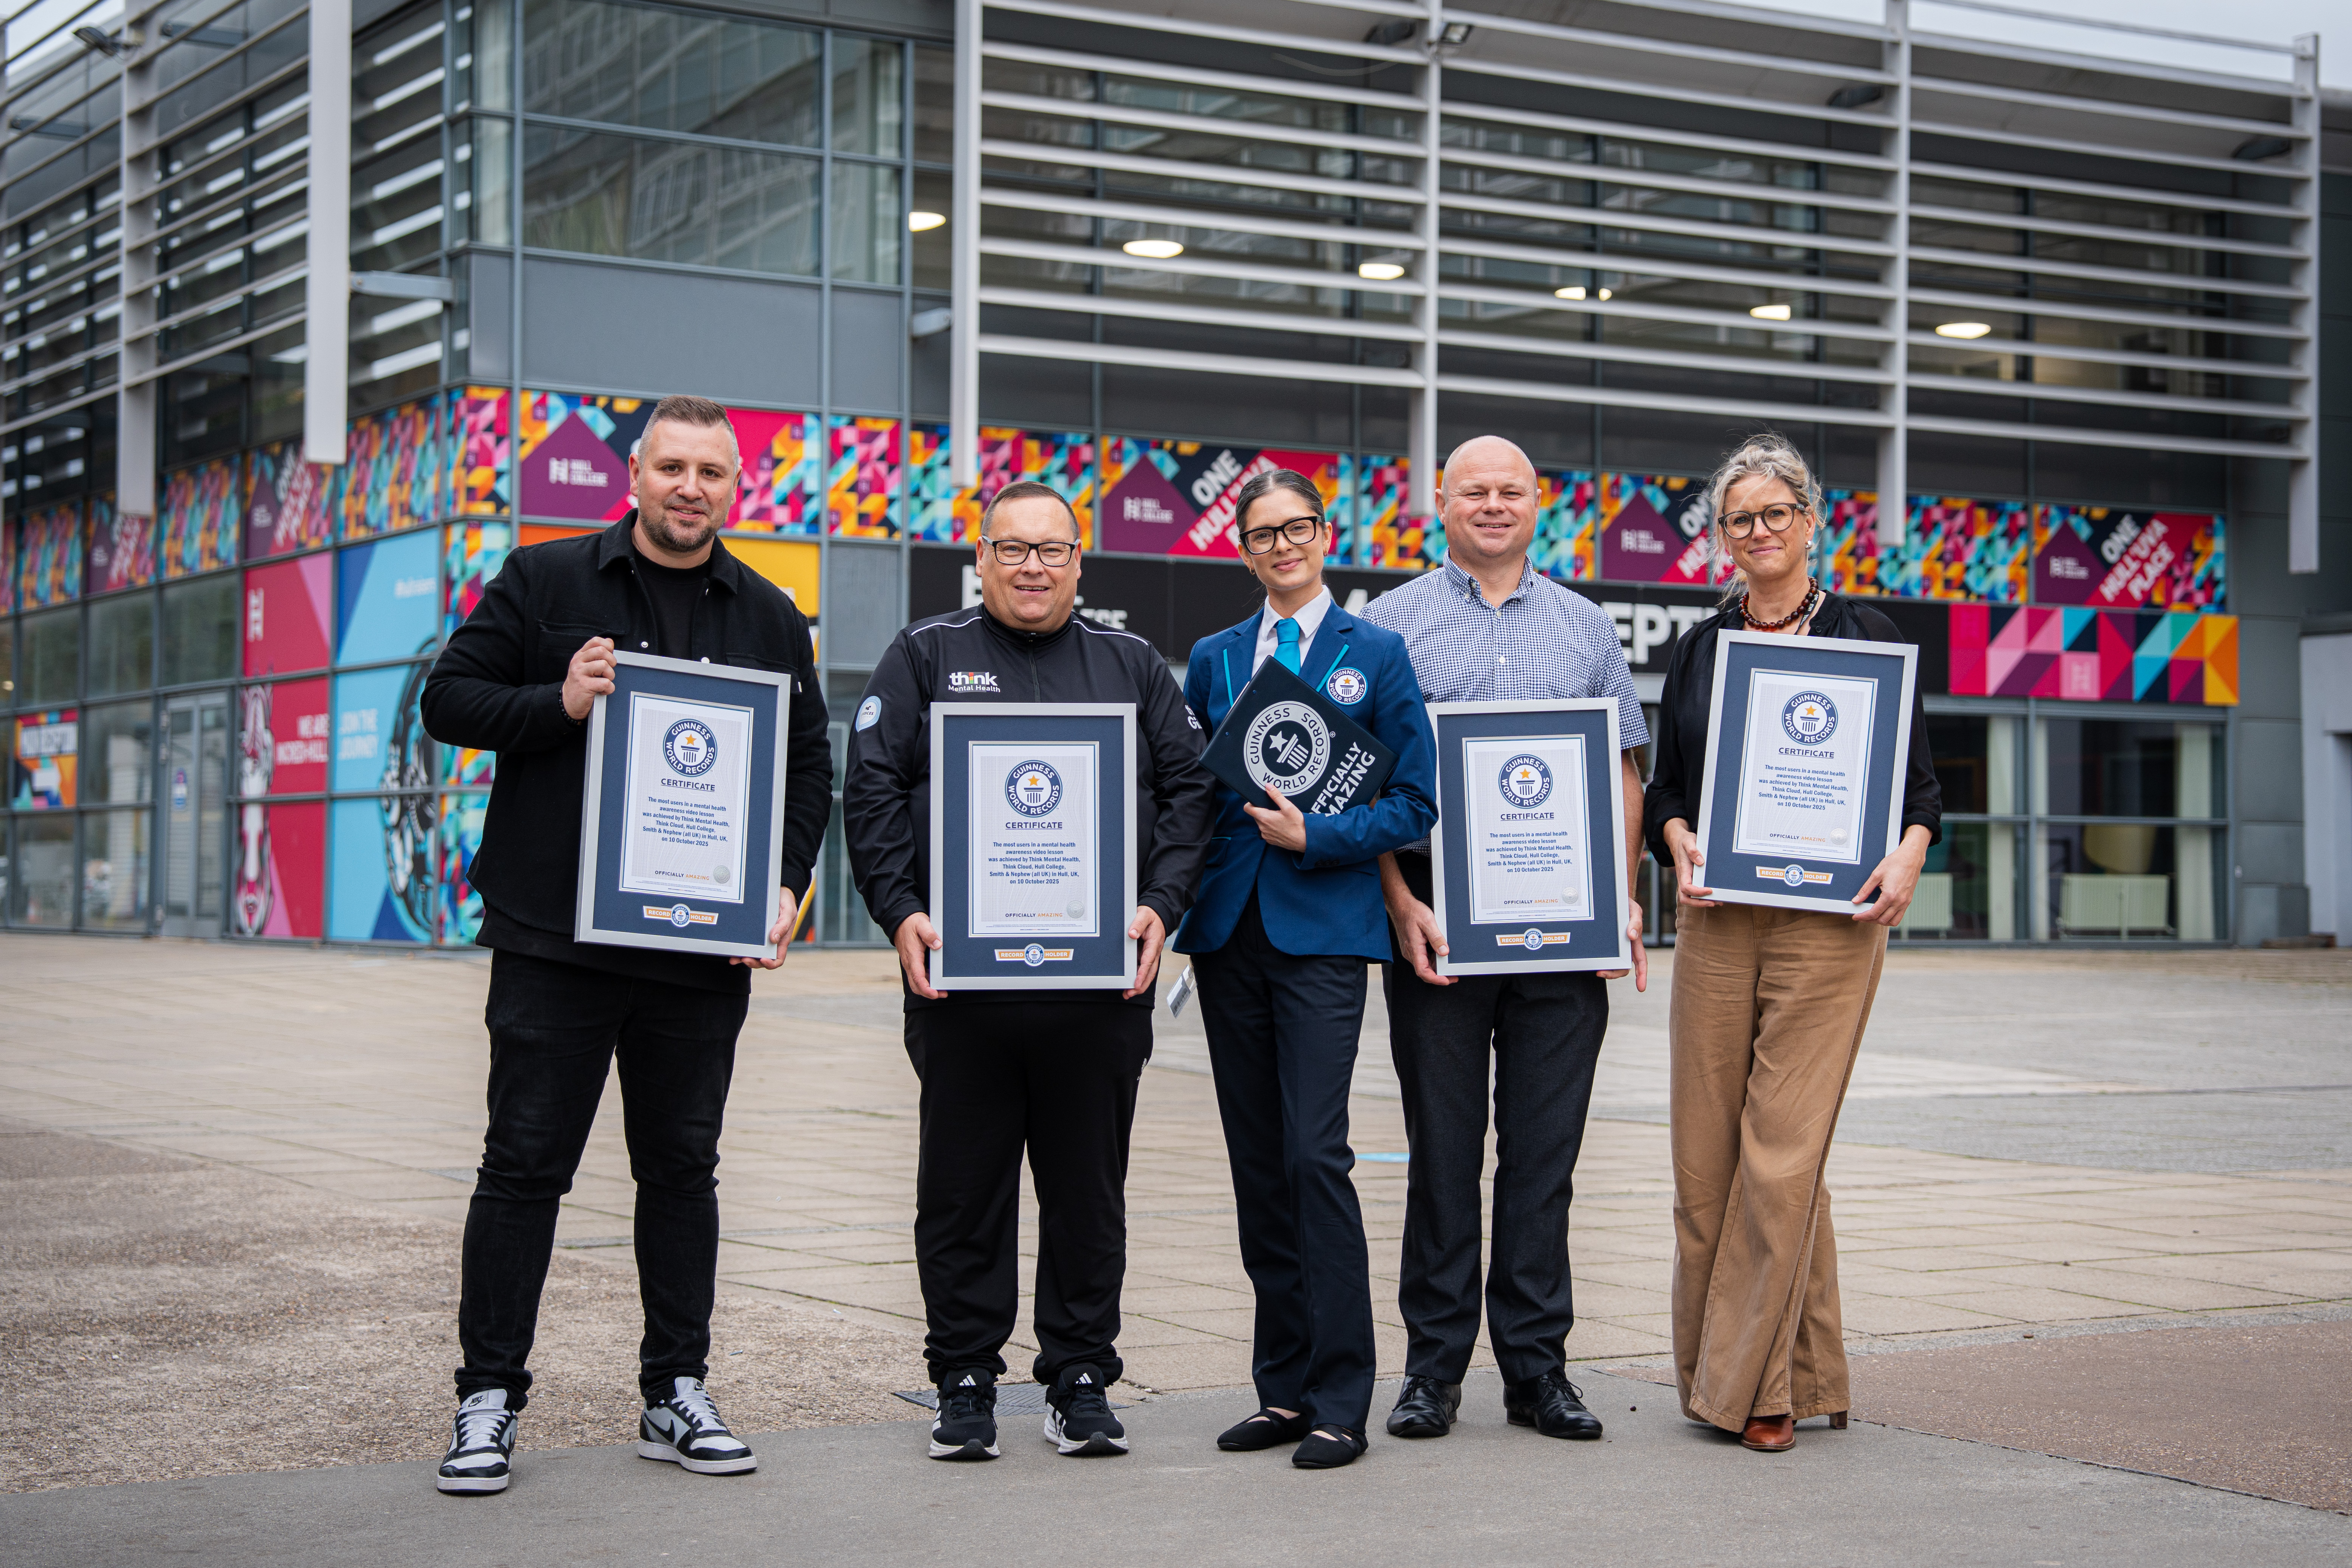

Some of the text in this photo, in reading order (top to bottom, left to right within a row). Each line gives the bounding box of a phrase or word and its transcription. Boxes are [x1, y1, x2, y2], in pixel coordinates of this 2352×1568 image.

[1192, 448, 1243, 507] ONE
[2101, 513, 2142, 564] ONE
[2127, 541, 2176, 602] PLACE
[949, 672, 998, 686] think
[1333, 670, 1362, 680] GUINNESS
[1330, 683, 1364, 702] WORLD RECORDS
[1791, 694, 1831, 710] GUINNESS
[672, 722, 711, 739] GUINNESS
[1250, 707, 1290, 765] GUINNESS
[1785, 713, 1835, 742] WORLD RECORDS
[666, 742, 714, 773] WORLD RECORDS
[1262, 713, 1324, 789] WORLD RECORDS
[1505, 757, 1544, 772] GUINNESS
[1779, 748, 1834, 758] CERTIFICATE
[661, 778, 715, 791] CERTIFICATE
[1013, 763, 1054, 778] GUINNESS
[1309, 741, 1362, 814] FFICIALLY
[1325, 751, 1376, 817] MAZING
[1008, 785, 1059, 814] WORLD RECORDS
[1502, 777, 1549, 805] WORLD RECORDS
[470, 1395, 483, 1404] NIKE
